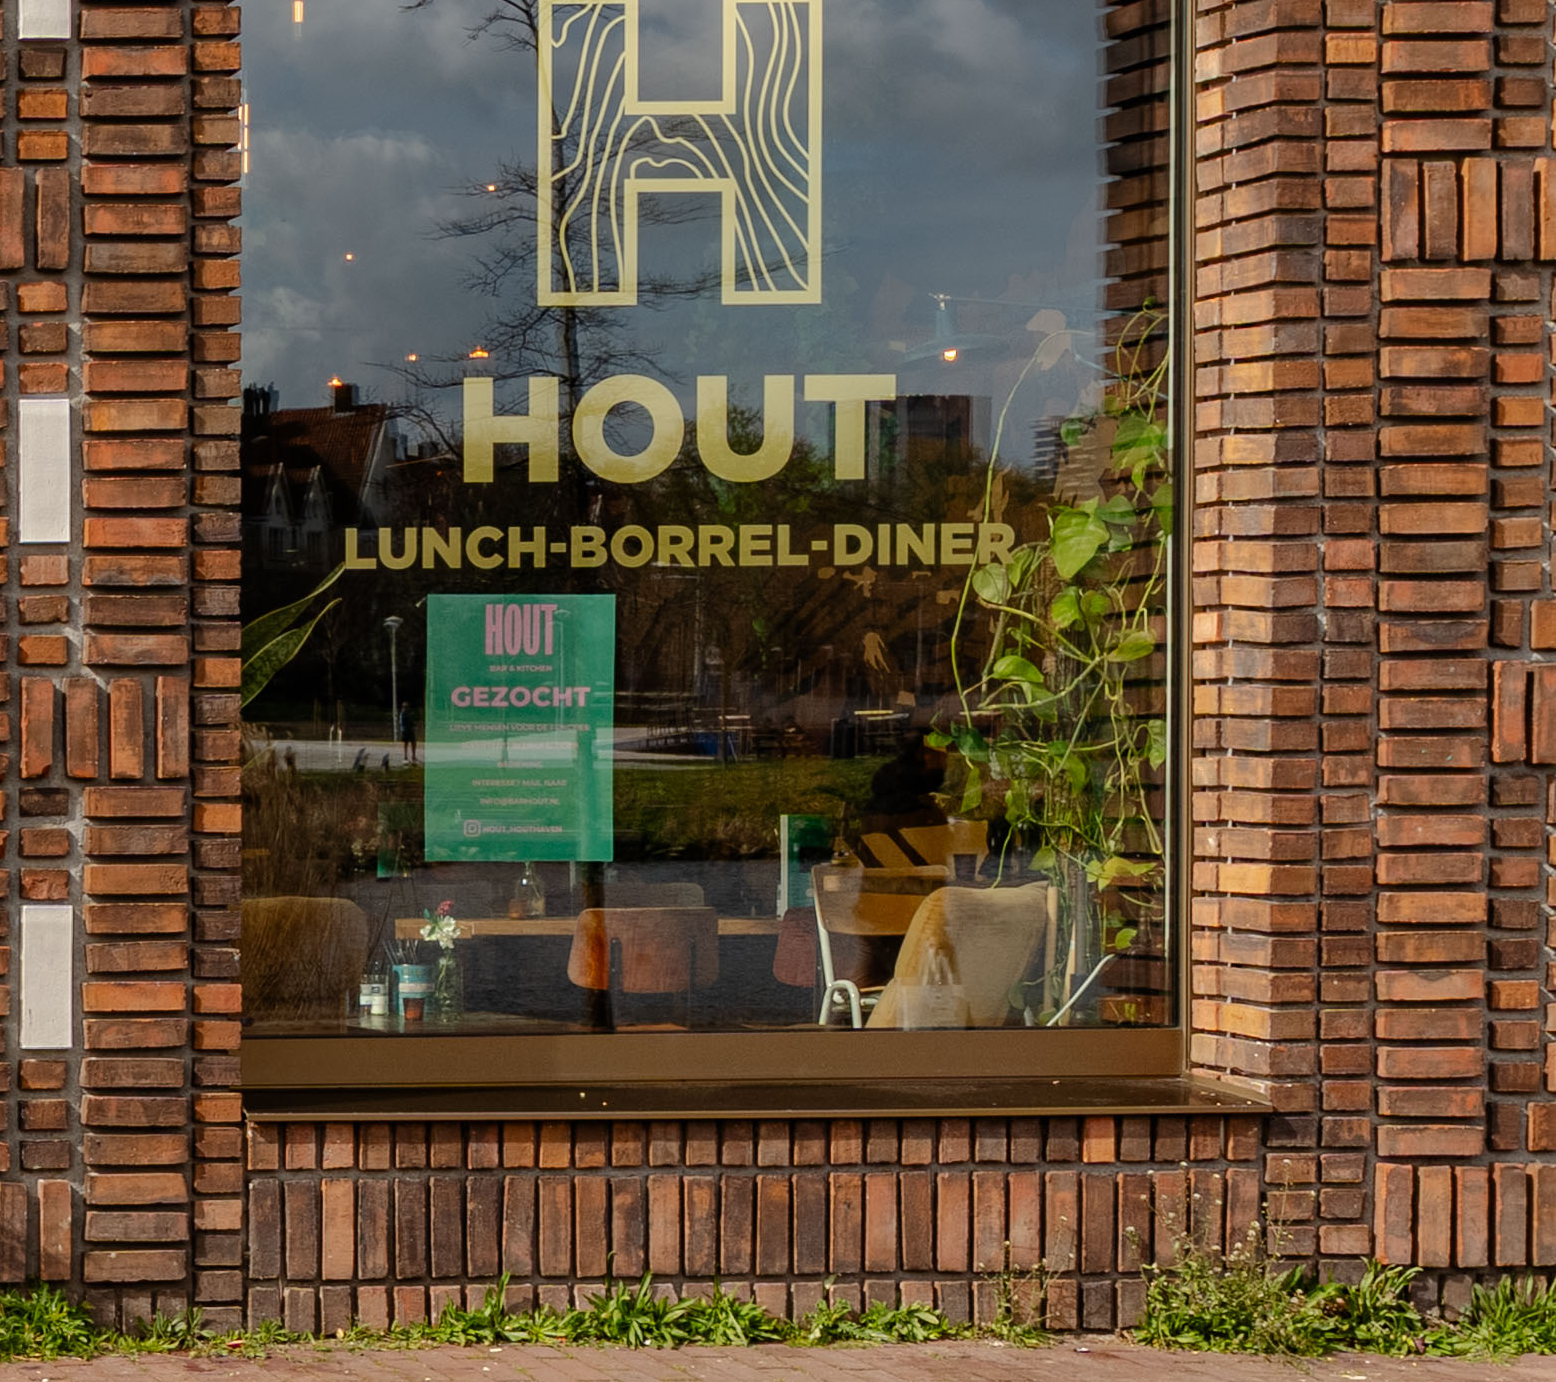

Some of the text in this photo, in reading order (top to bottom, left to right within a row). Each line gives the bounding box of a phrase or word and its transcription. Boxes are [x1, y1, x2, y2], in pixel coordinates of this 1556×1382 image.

[463, 374, 897, 483] HOUT
[345, 522, 1017, 569] LUNCH-BORREL-DINER
[485, 604, 558, 655] HOUT
[451, 686, 591, 708] GEZOCHT
